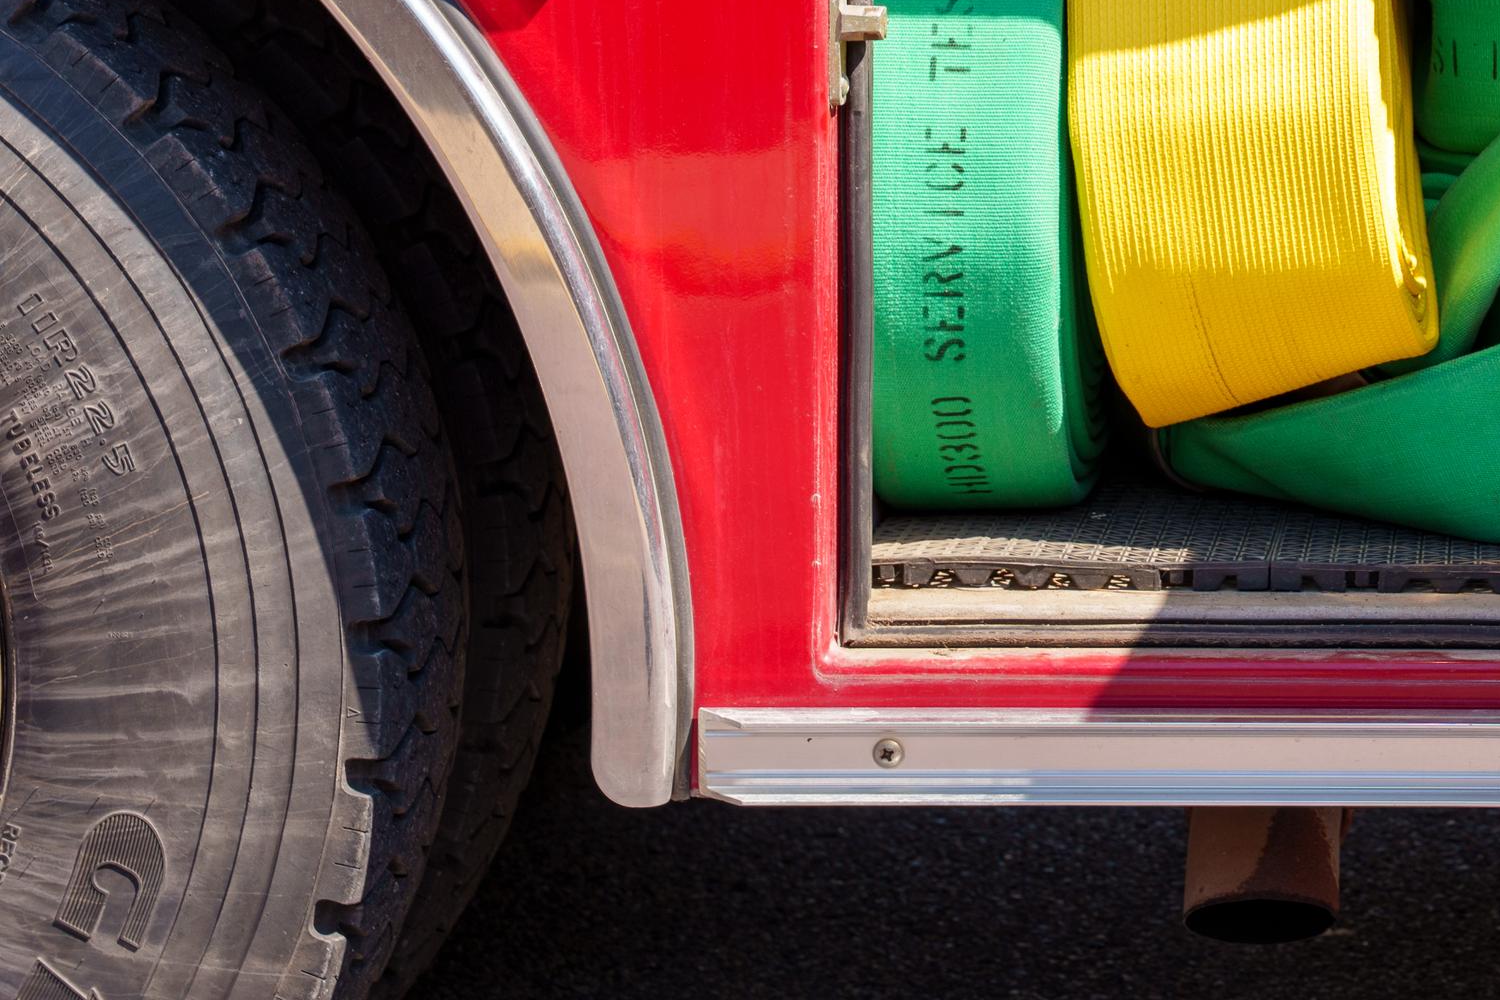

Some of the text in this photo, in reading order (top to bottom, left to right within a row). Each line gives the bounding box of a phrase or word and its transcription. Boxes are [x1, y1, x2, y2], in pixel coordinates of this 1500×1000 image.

[923, 127, 968, 363] SERVICE
[17, 292, 137, 477] 11R22.5
[26, 341, 50, 373] LOAD
[0, 408, 62, 521] TUBELESS
[931, 395, 992, 496] HD300
